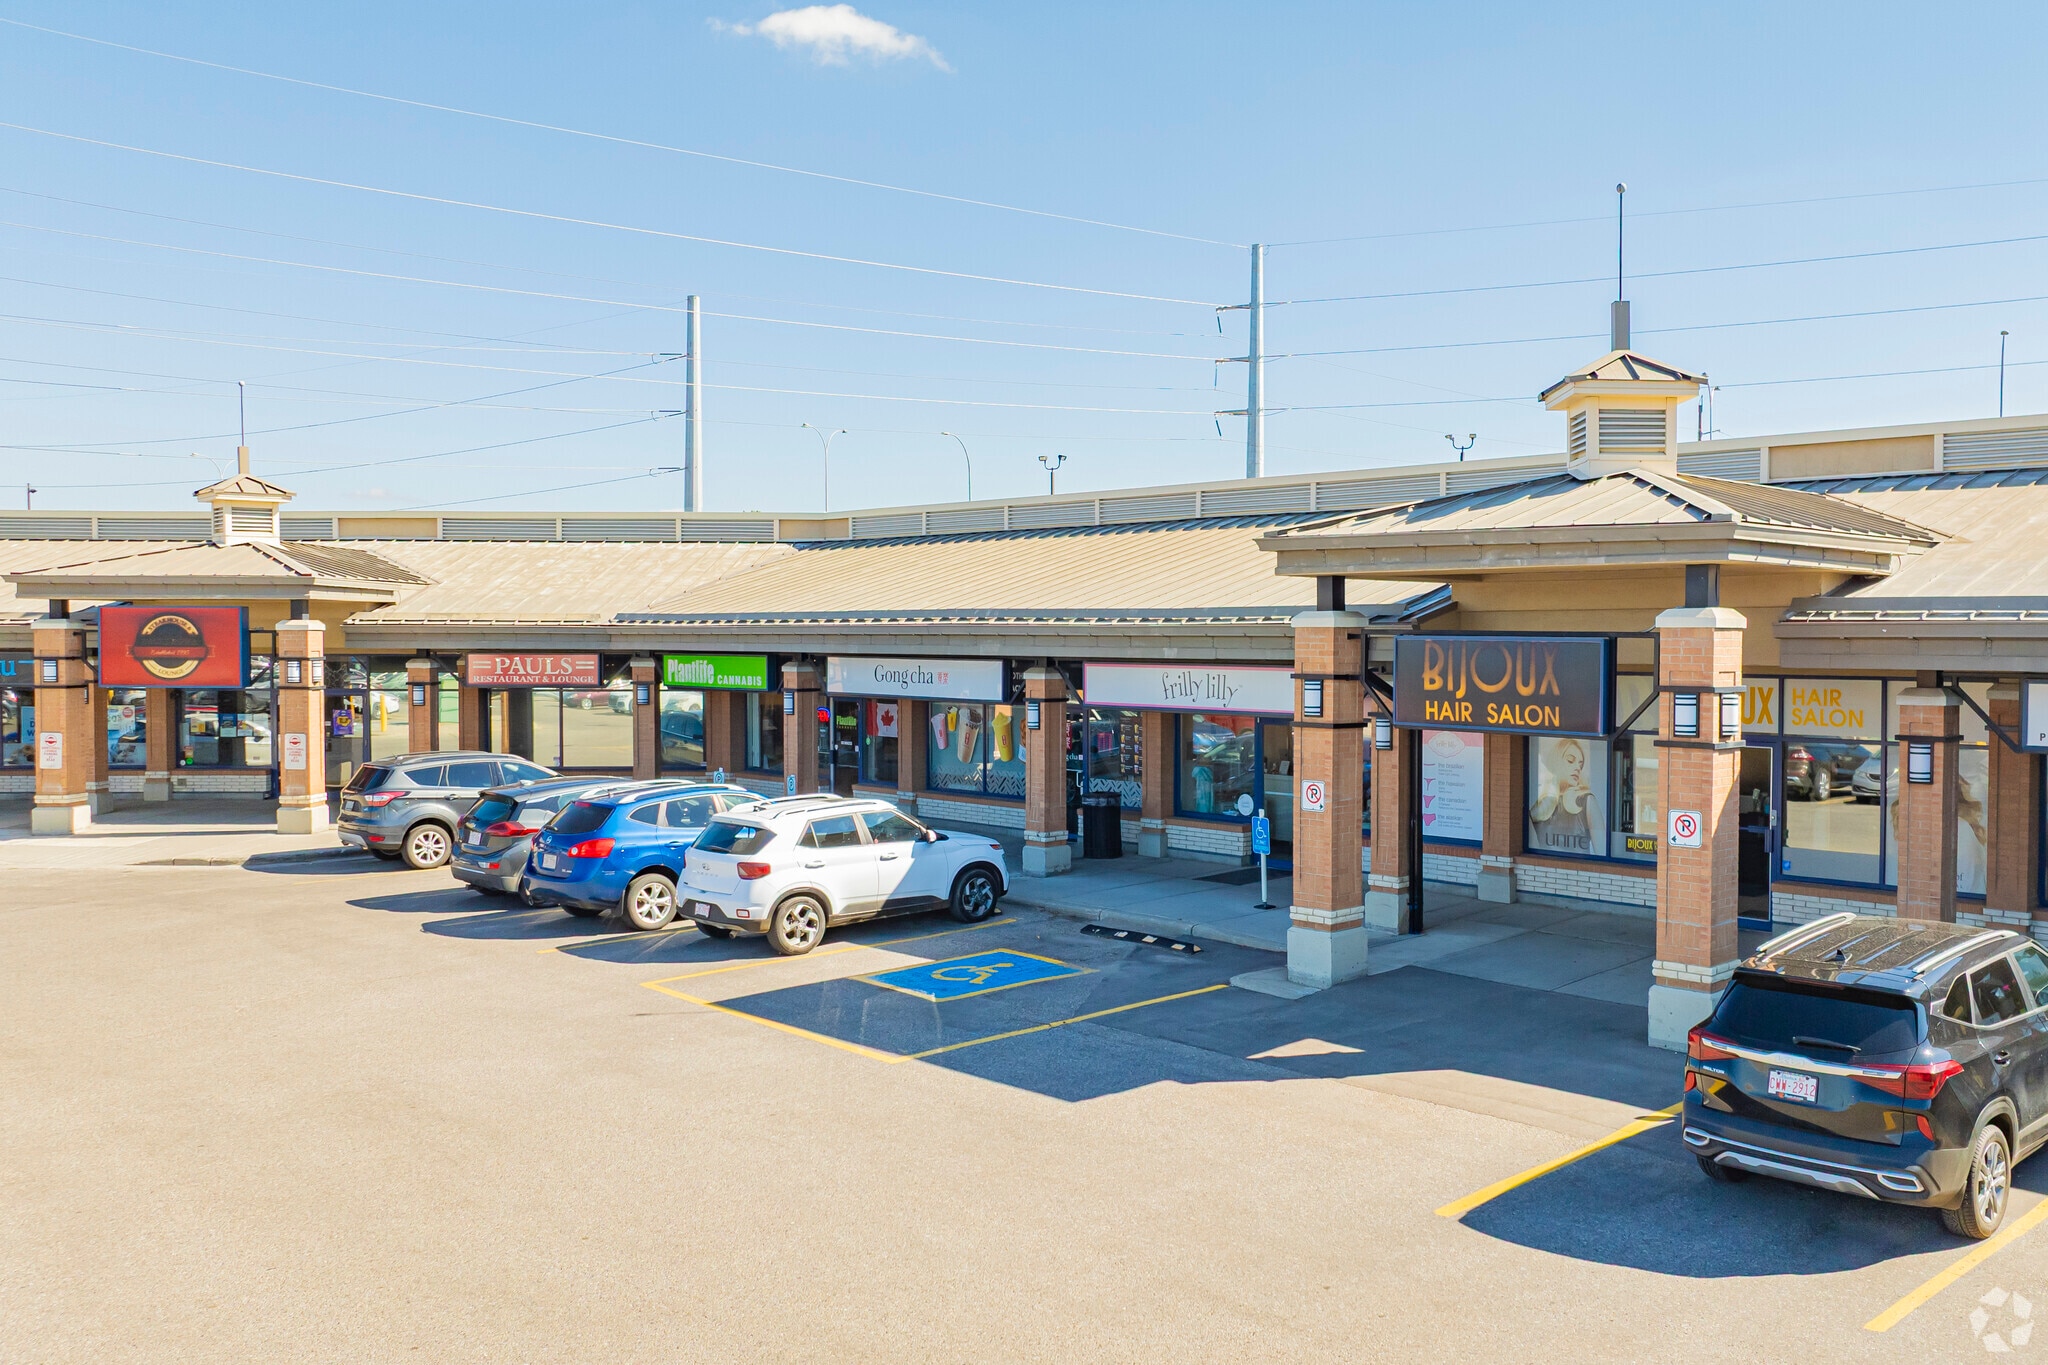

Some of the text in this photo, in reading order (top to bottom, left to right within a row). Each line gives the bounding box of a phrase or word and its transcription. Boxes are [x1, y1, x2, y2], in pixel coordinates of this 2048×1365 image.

[494, 656, 573, 675] PAULS
[667, 659, 762, 686] Plantlife CANNABIS
[874, 664, 934, 690] Gong cha
[1422, 639, 1560, 699] BIJOUX
[473, 675, 541, 683] RESTAURANT
[552, 676, 595, 684] LOUNGE
[1161, 671, 1239, 708] frilly lilly
[1791, 687, 1842, 707] HAIR
[1425, 699, 1560, 727] HAIR SALON
[1791, 708, 1864, 728] SALON
[1627, 838, 1653, 851] BIJOUX
